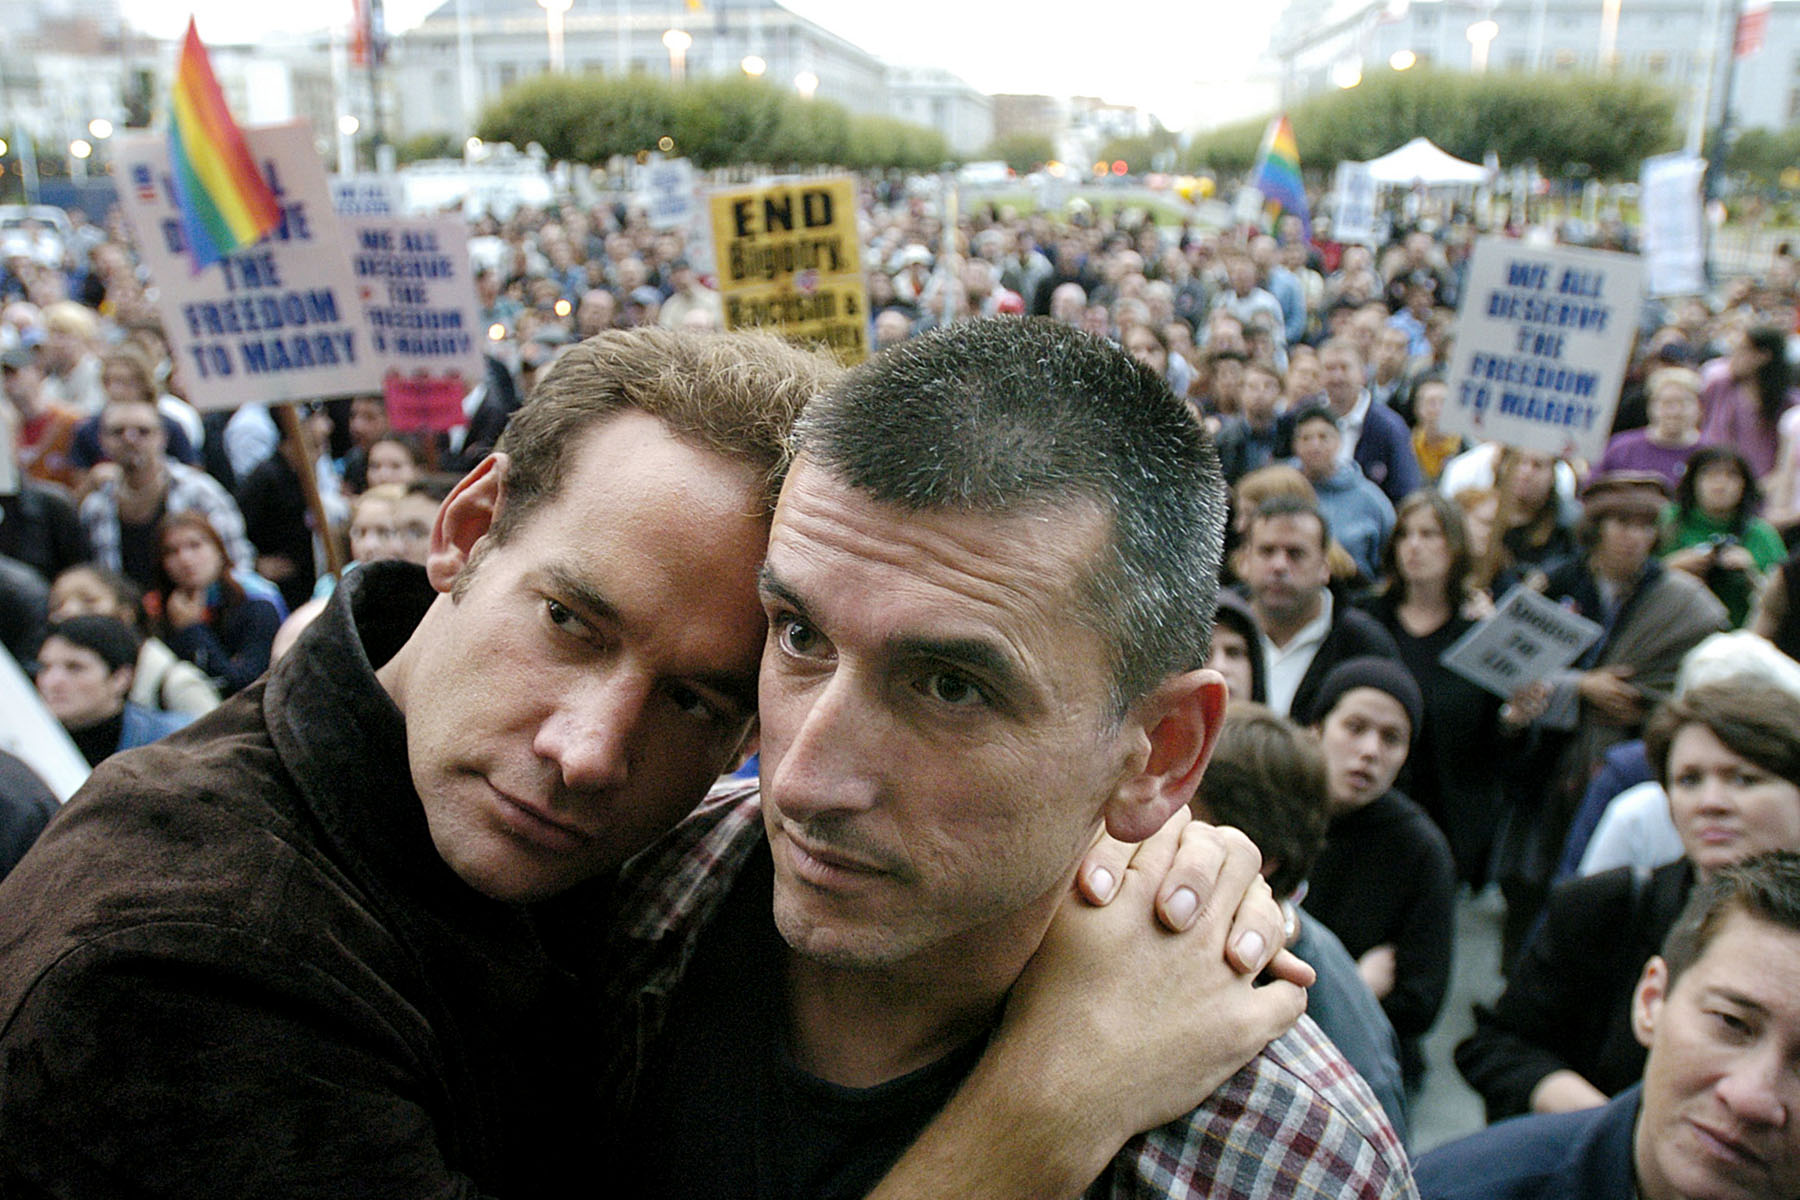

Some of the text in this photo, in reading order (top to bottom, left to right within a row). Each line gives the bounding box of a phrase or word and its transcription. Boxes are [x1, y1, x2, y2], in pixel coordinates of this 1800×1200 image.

[732, 189, 834, 238] END
[358, 229, 438, 251] WE ALL
[219, 250, 281, 292] THE
[1507, 261, 1604, 297] WE ALL
[183, 287, 340, 338] FREEDOM
[1487, 291, 1610, 331] DESERVE
[191, 328, 355, 379] TO MARRY
[1517, 325, 1565, 358] THE
